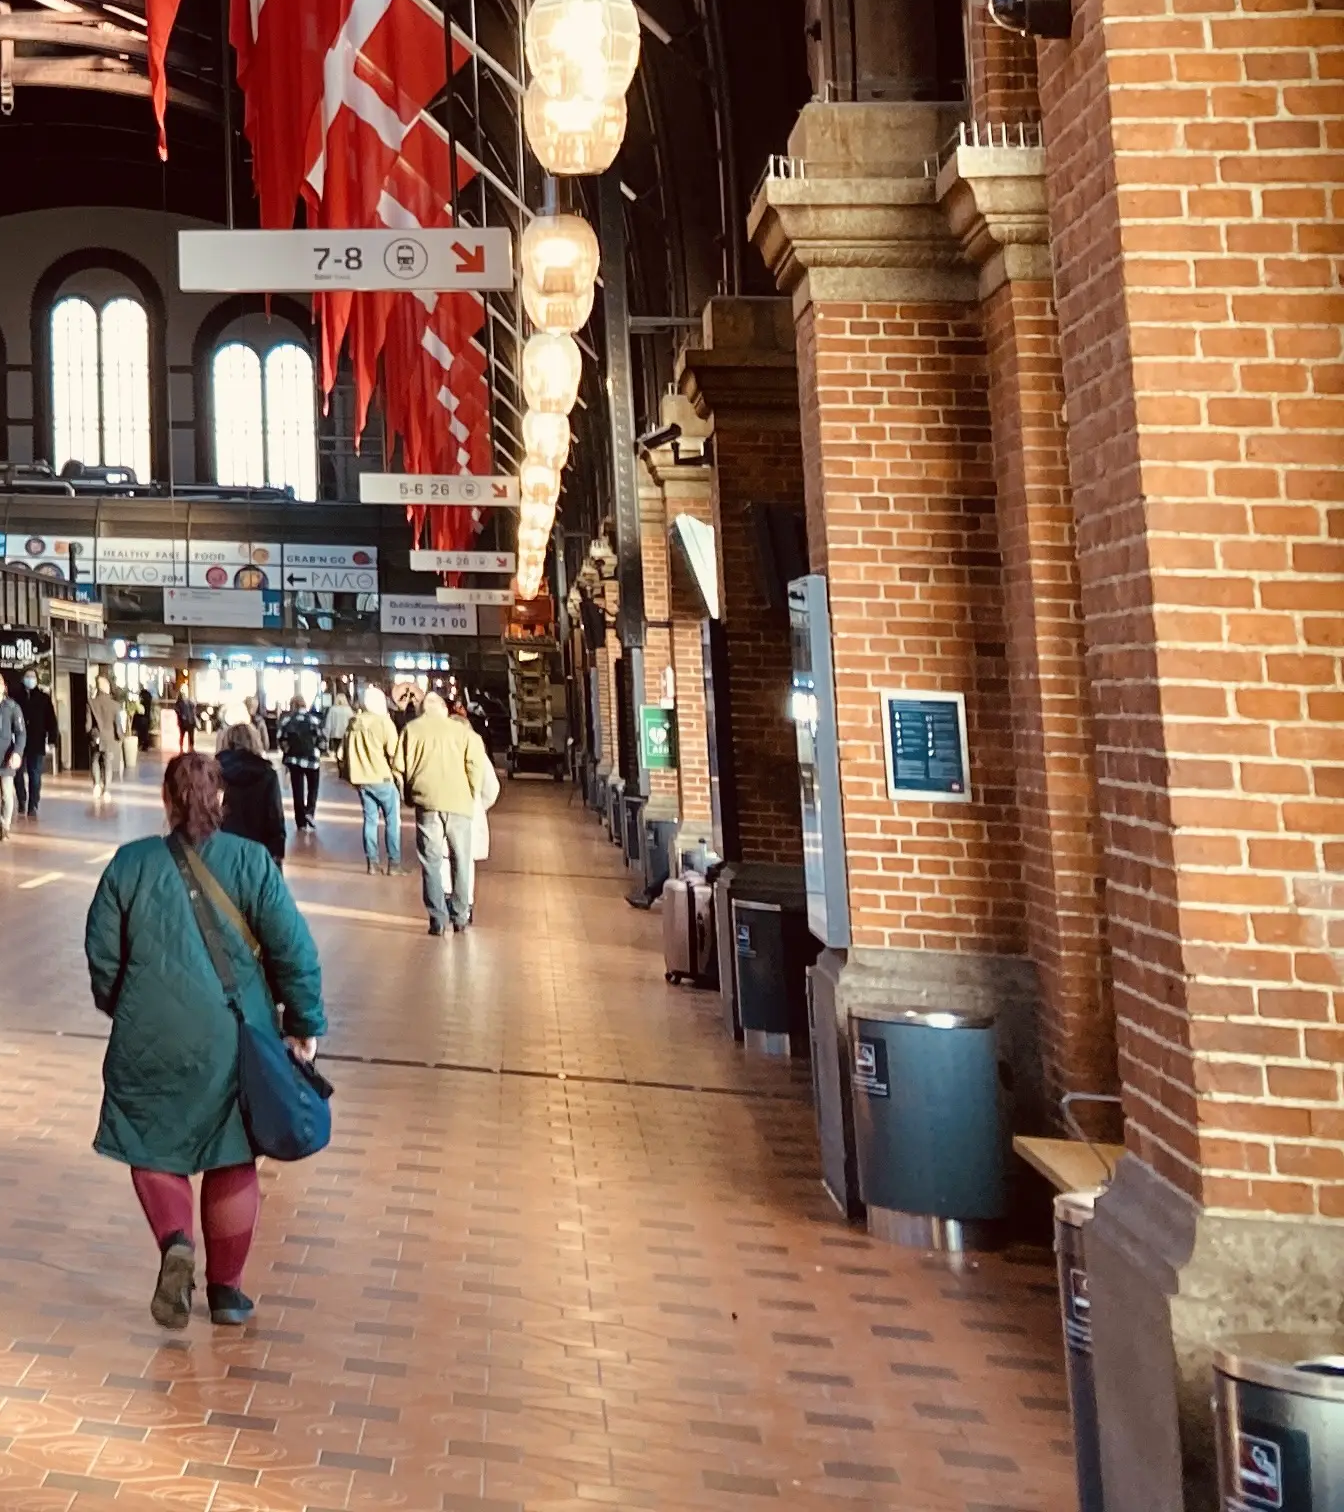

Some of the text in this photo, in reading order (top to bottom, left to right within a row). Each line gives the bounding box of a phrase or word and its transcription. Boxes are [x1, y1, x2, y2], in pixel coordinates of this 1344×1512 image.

[314, 247, 363, 271] 7-8
[399, 482, 450, 496] 5-6 26
[104, 549, 149, 559] HEALTHY
[330, 555, 346, 564] GO
[391, 615, 467, 629] 70 12 21 00
